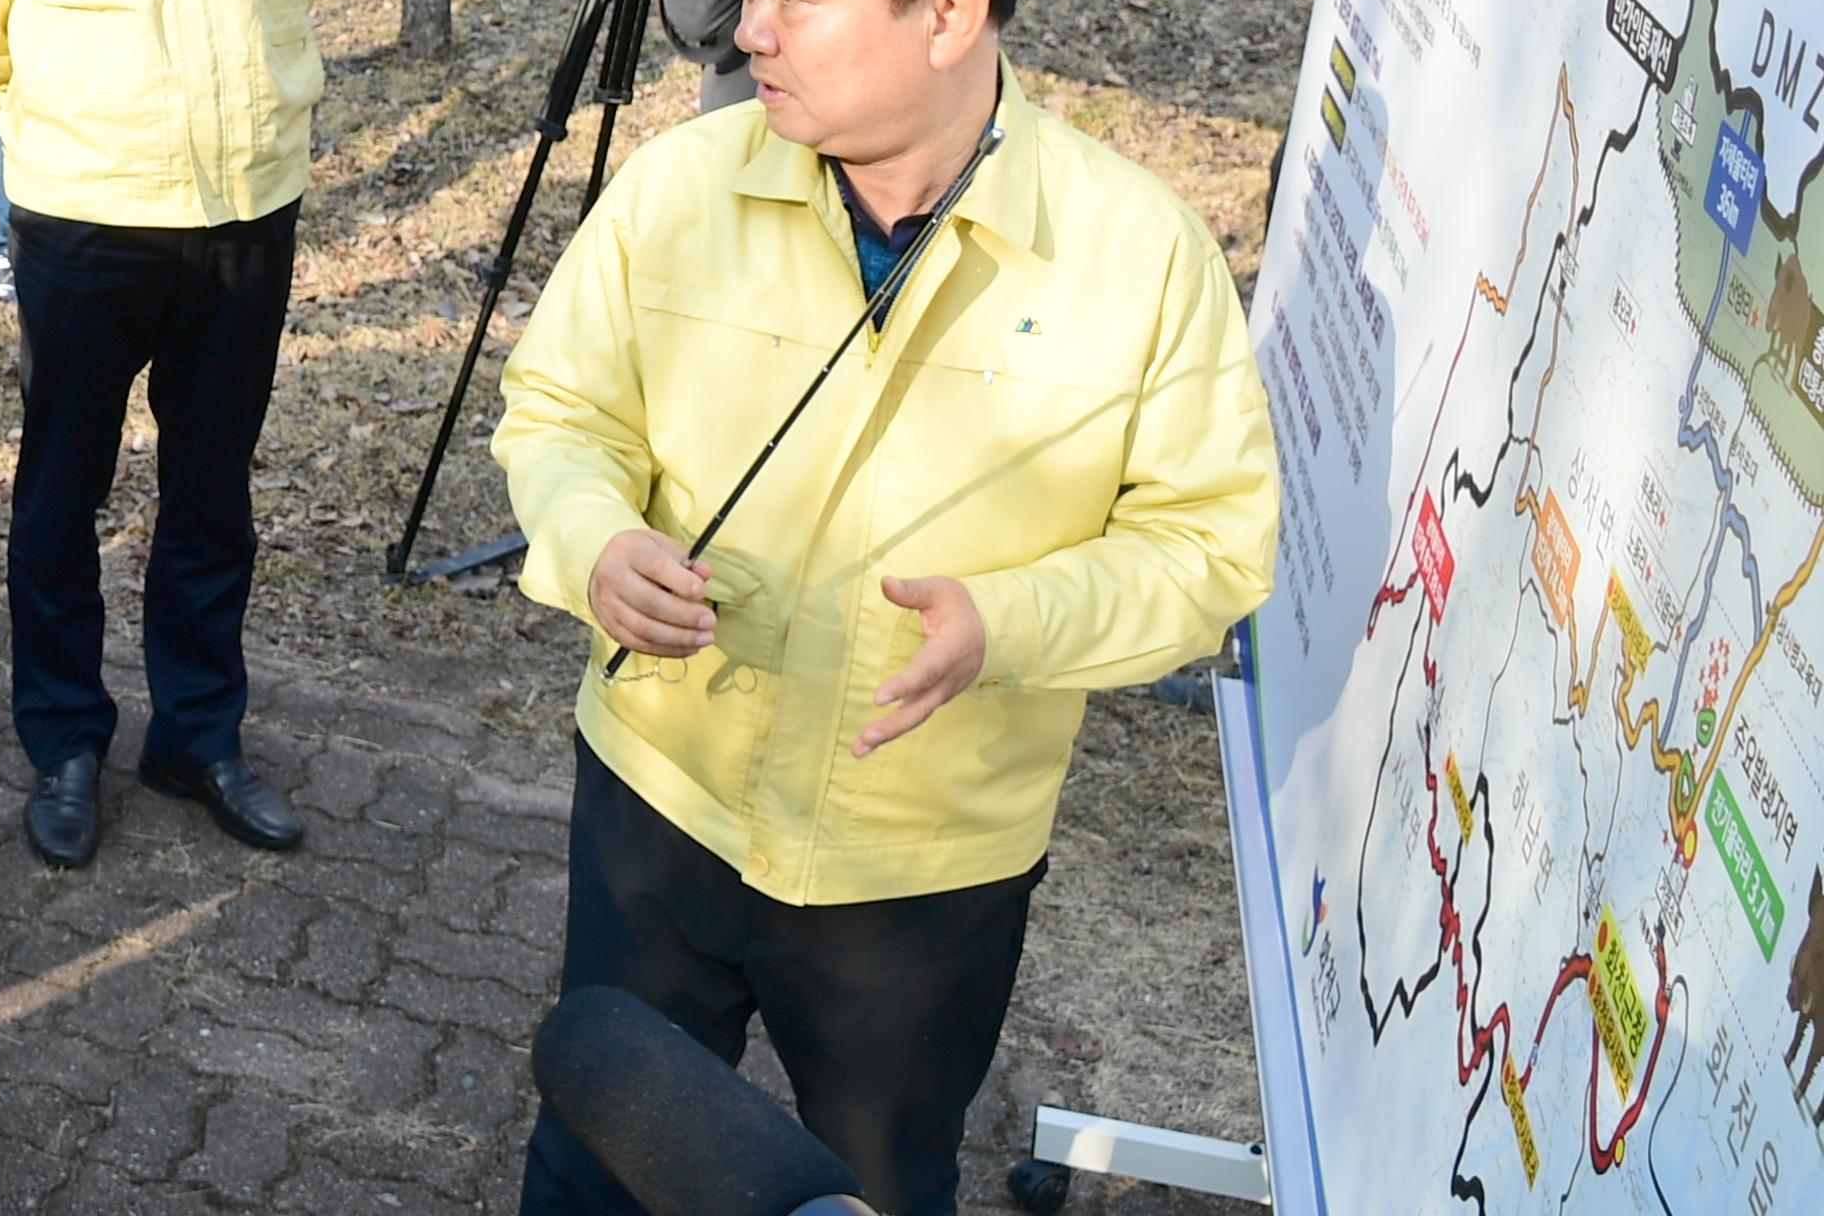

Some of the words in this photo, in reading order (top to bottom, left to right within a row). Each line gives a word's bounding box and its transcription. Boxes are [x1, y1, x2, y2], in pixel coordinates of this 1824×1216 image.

[1612, 284, 1633, 335] 봉오리
[1727, 273, 1755, 329] 산양리
[1567, 446, 1616, 564] 상서면
[1511, 769, 1555, 906] 하남면
[1710, 788, 1755, 892] 전기울타리
[1733, 714, 1799, 865] 주요발생지역
[1604, 937, 1647, 1059] 화천군청
